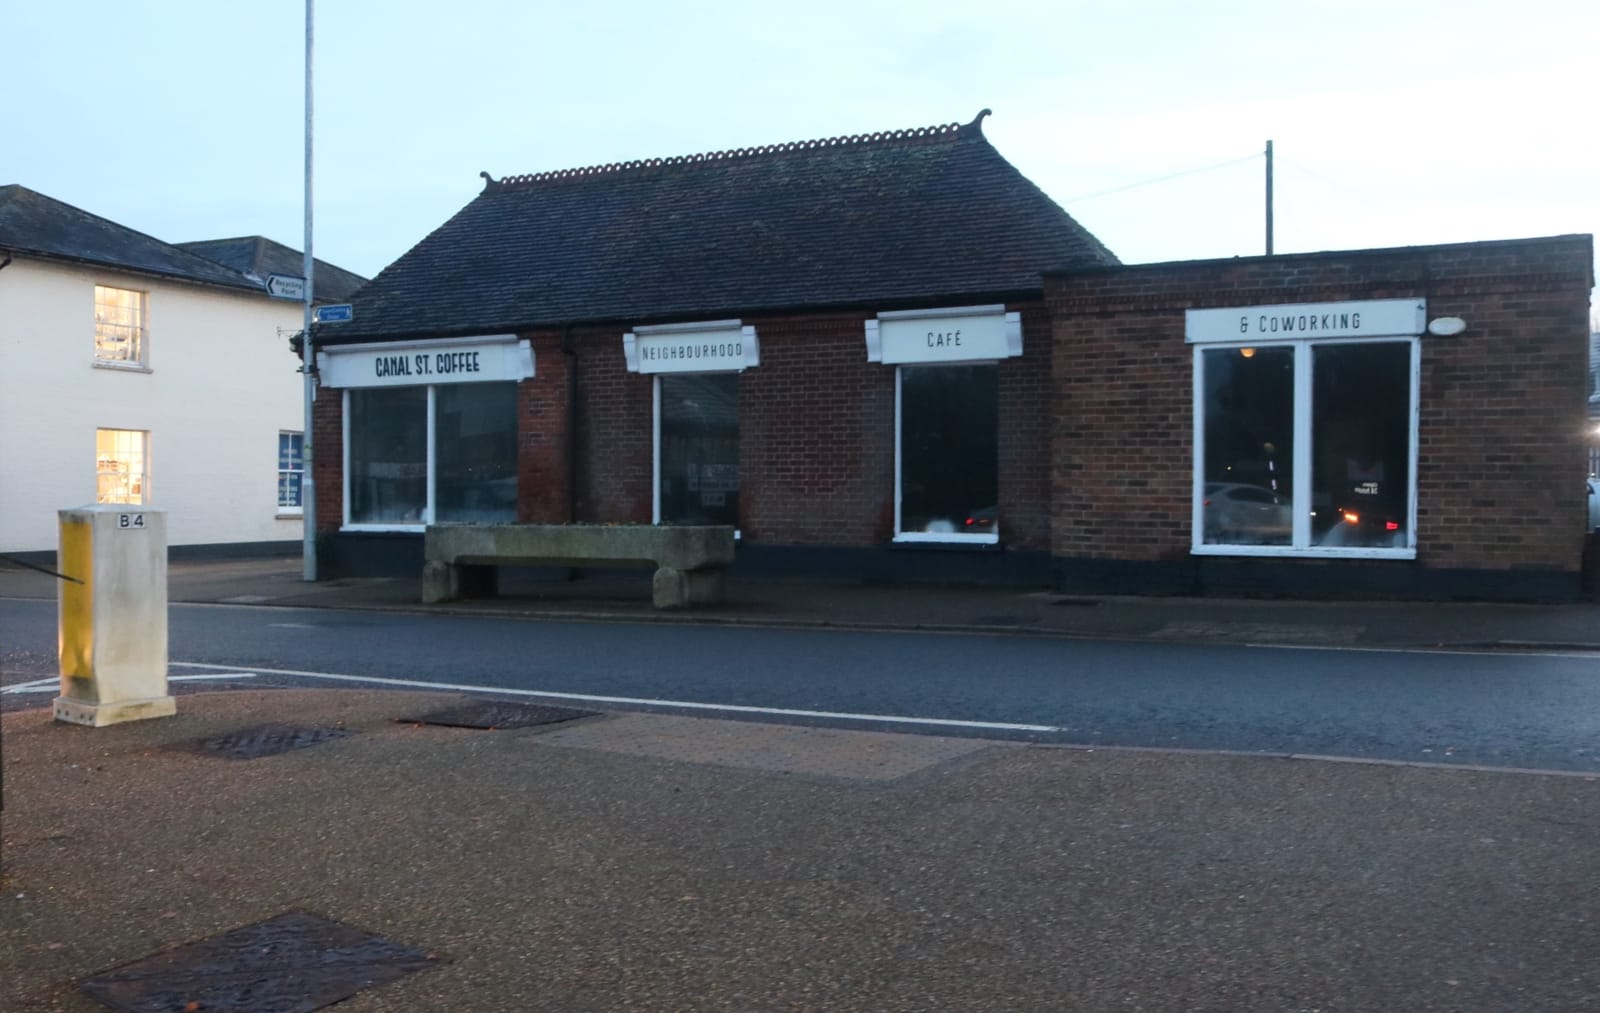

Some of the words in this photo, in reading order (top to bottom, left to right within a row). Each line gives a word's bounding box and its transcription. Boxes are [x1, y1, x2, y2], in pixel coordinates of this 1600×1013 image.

[1240, 316, 1248, 333] &
[1259, 312, 1361, 333] COWORKING
[927, 329, 961, 347] CAFÉ
[642, 343, 742, 360] NEIGHBOURHOOD
[375, 355, 412, 377] CANAL
[415, 354, 432, 375] ST.
[436, 351, 480, 374] COFFEE
